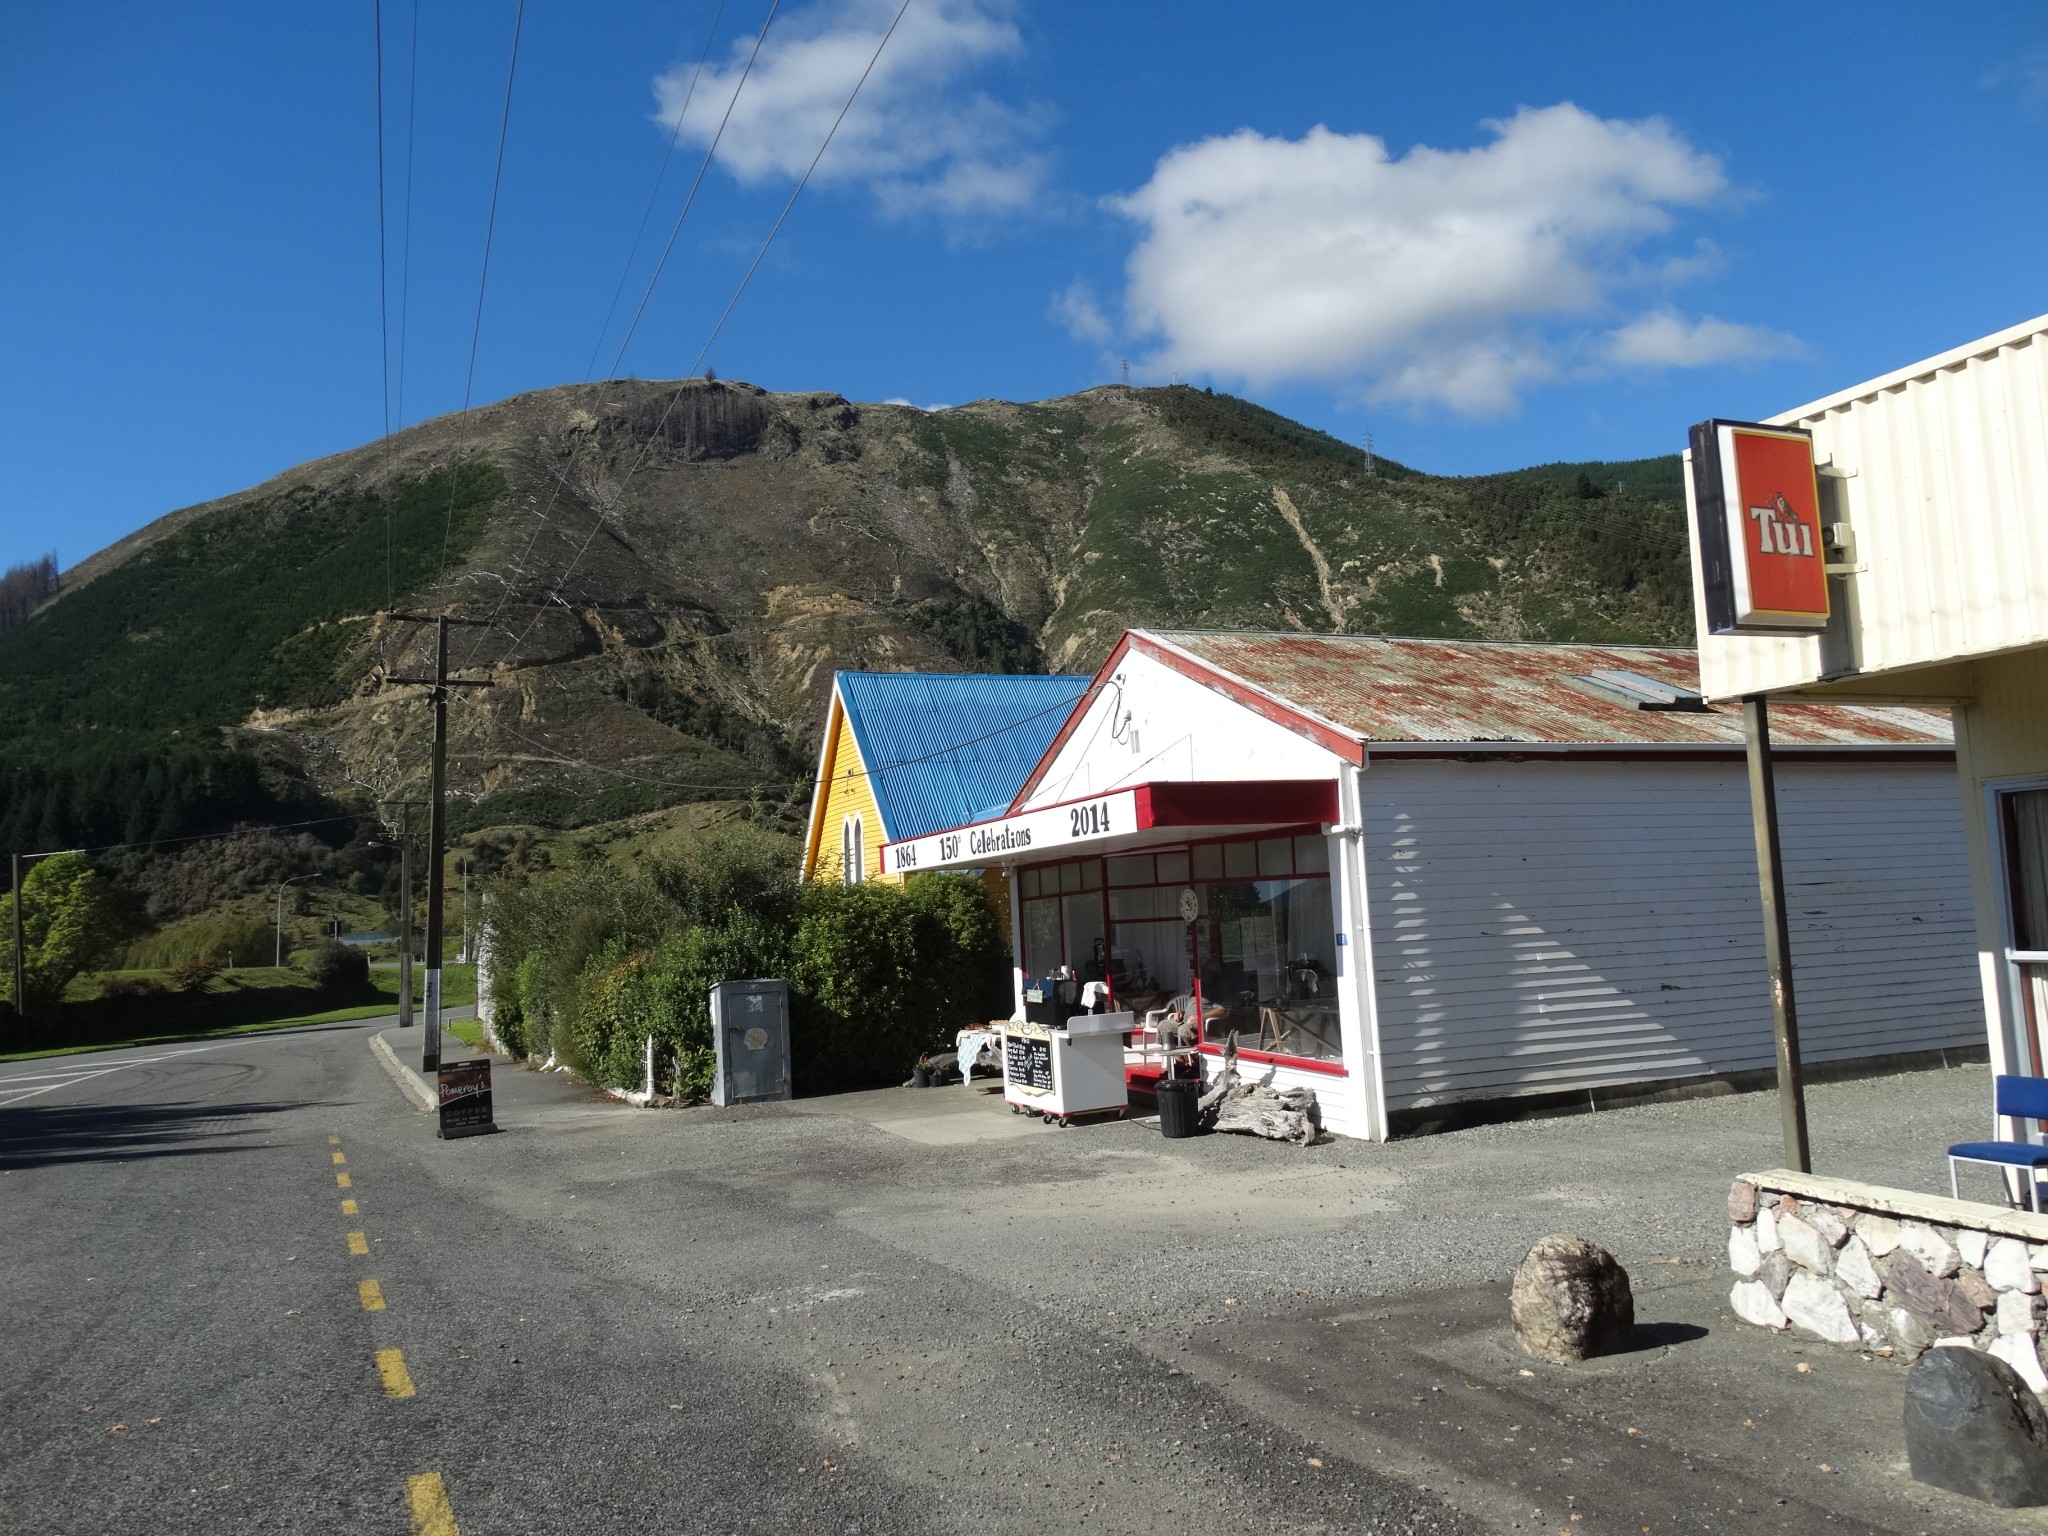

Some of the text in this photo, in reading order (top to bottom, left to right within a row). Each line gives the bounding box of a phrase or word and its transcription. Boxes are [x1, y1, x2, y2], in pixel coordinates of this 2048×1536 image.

[896, 843, 917, 869] 1864
[970, 825, 1031, 855] Celebrations
[1070, 801, 1110, 837] 2014
[440, 1073, 485, 1098] Pomeroy's
[446, 1106, 488, 1117] COFFEE
